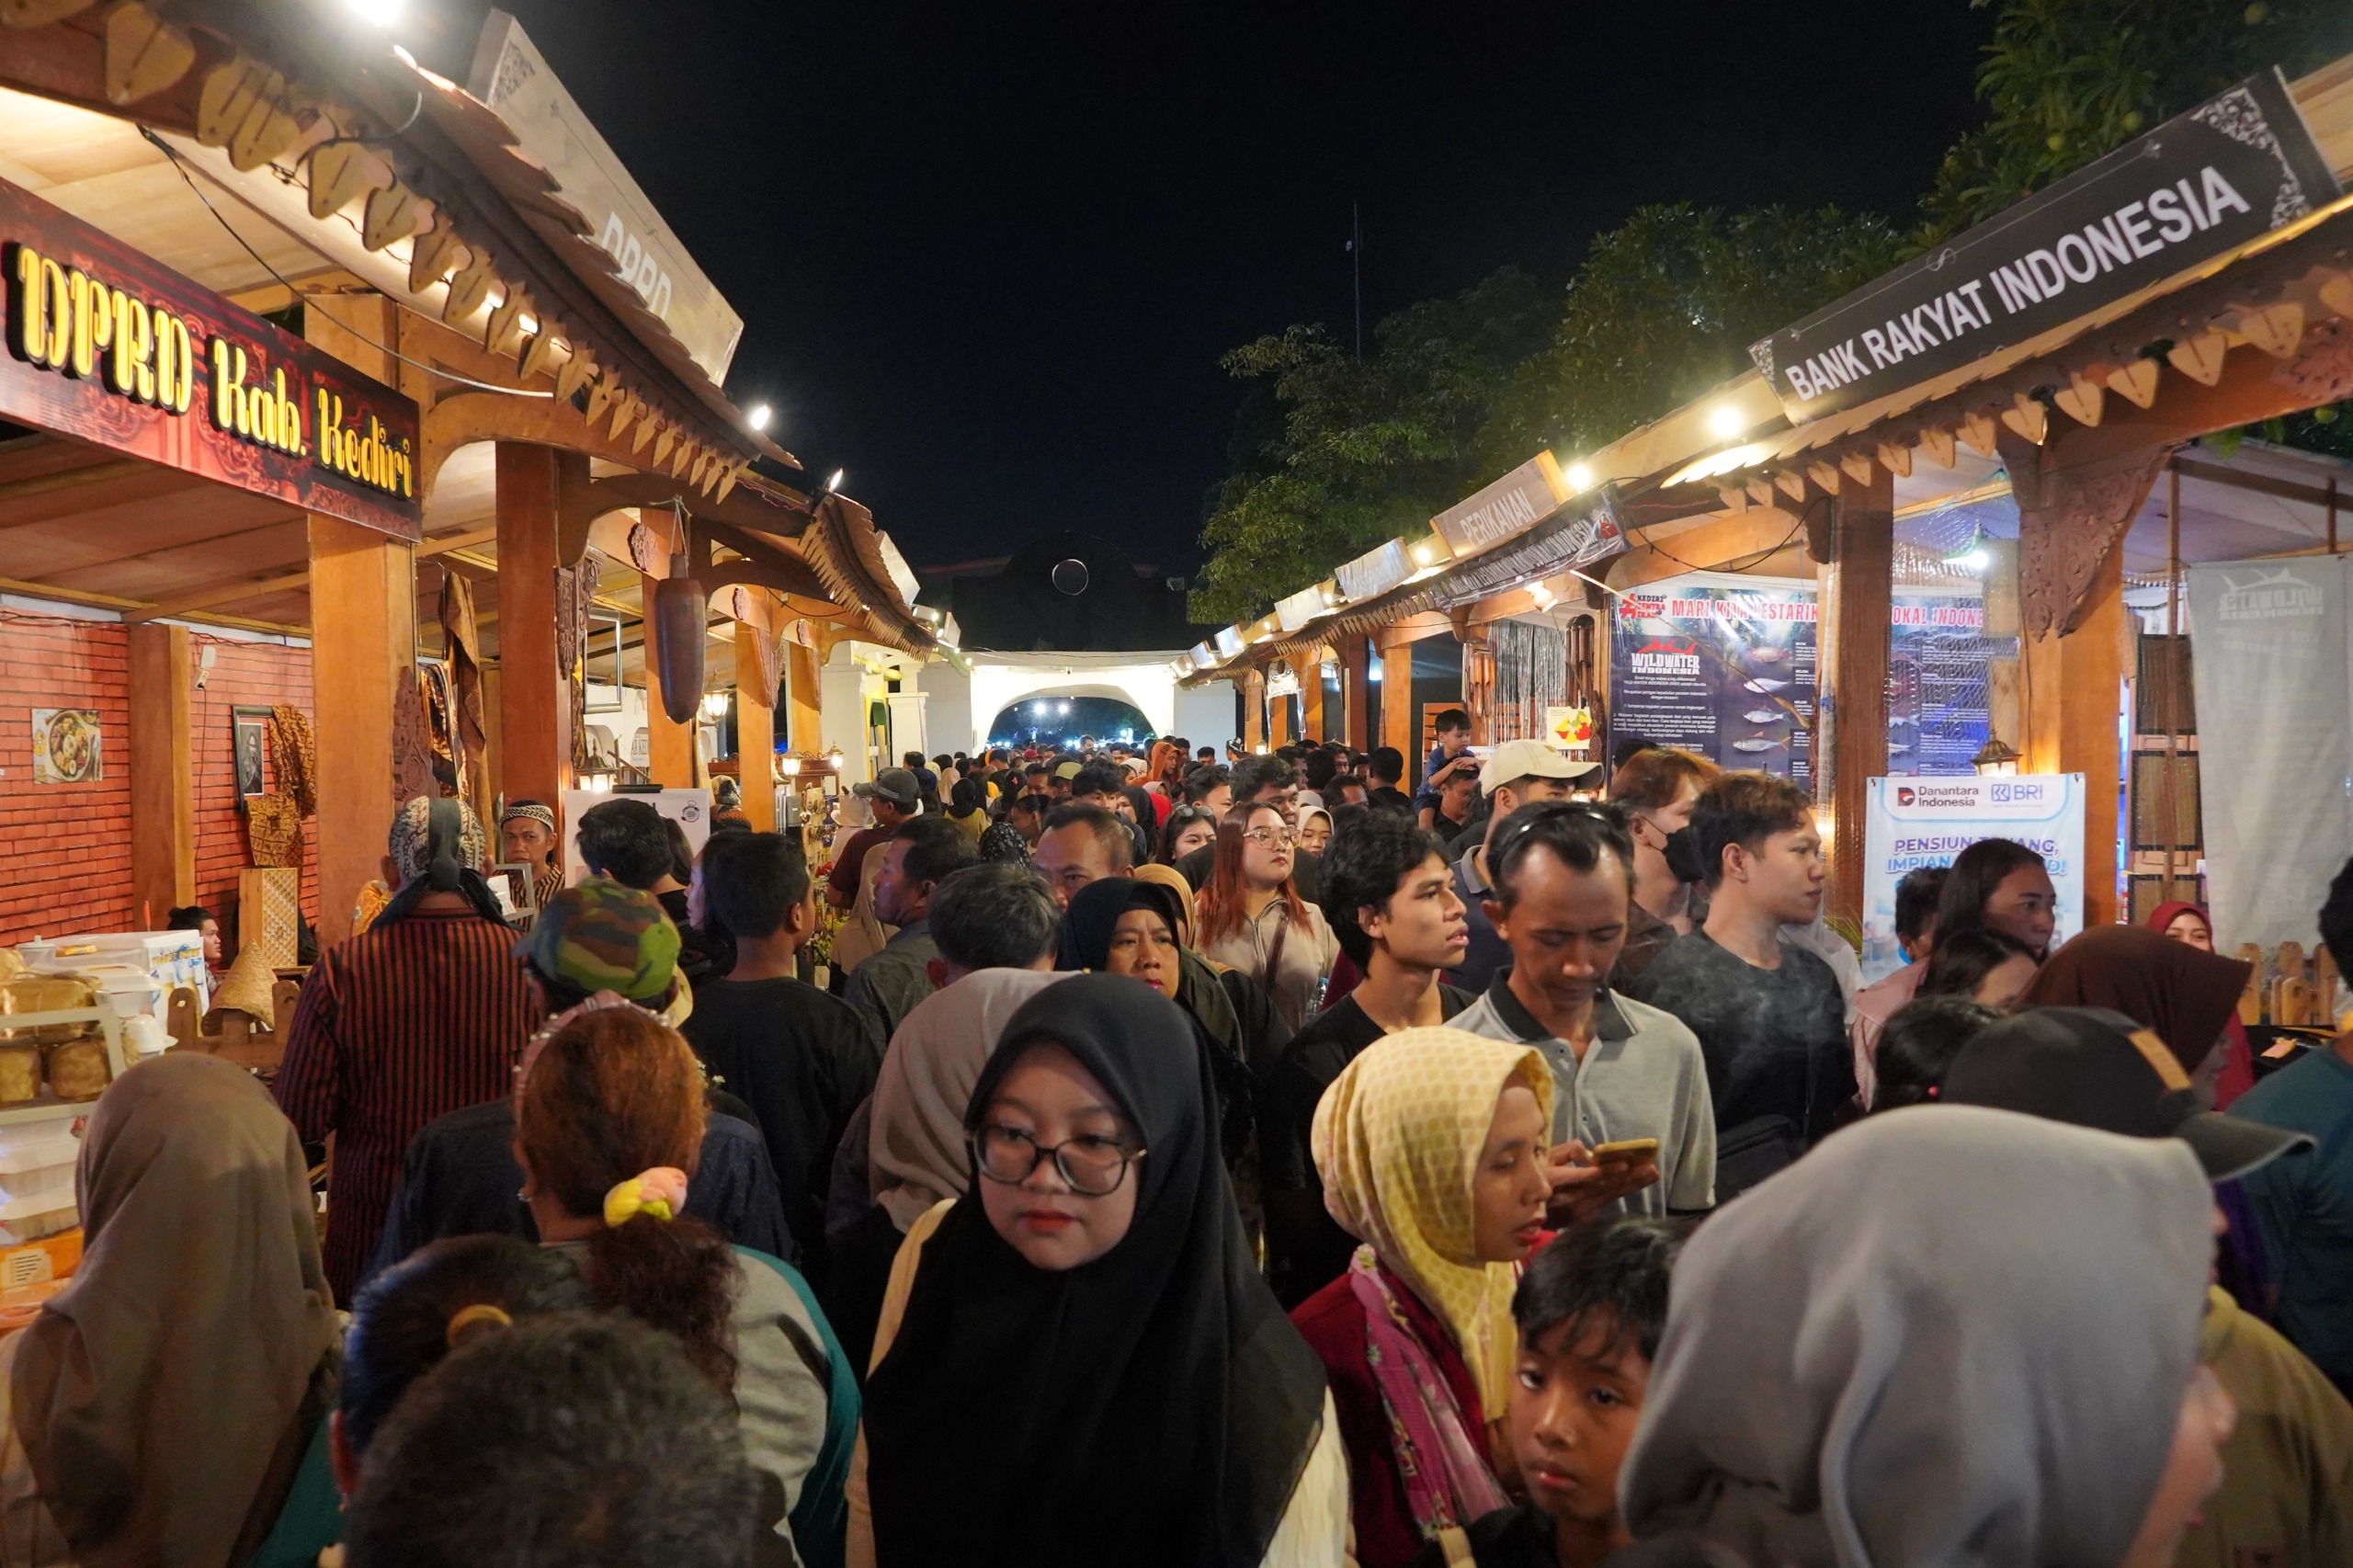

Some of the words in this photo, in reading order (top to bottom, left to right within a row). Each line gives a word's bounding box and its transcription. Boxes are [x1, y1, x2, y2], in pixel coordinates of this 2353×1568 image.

[1785, 341, 1871, 402] BANK
[1860, 279, 1993, 369] RAKYAT
[1988, 165, 2250, 314] INDONESIA
[18, 246, 193, 414] DPRD
[212, 337, 307, 456] Kab.
[317, 387, 413, 498] Kediri
[1459, 487, 1537, 548] PERIKANAN
[1637, 595, 1665, 603] KEDIRI
[1672, 599, 1711, 618] MARI
[1893, 606, 1927, 625] OKAL
[1631, 666, 1700, 676] INDONESIA
[1918, 786, 1979, 796] Danantara
[2014, 784, 2043, 801] BRI
[1918, 798, 1975, 807] Indonesia
[1893, 835, 1972, 855] PENSIUN
[1886, 855, 1951, 873] IMPIAN
